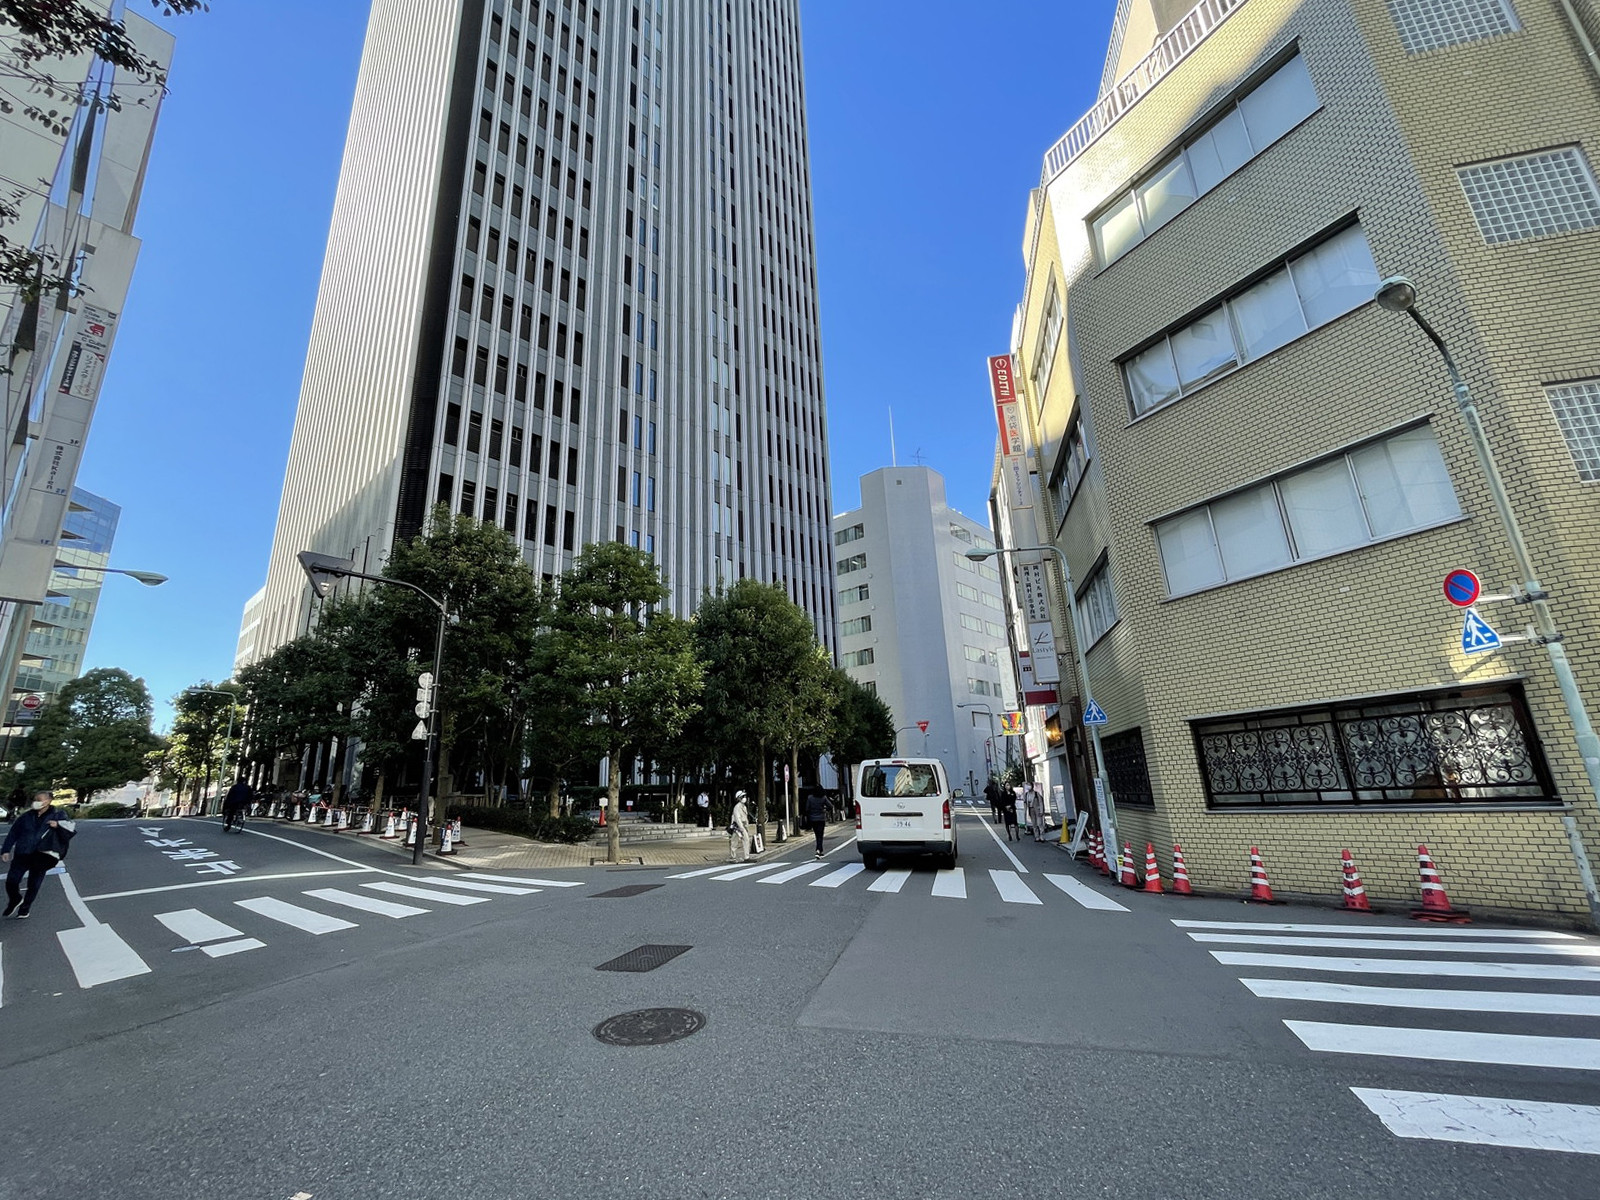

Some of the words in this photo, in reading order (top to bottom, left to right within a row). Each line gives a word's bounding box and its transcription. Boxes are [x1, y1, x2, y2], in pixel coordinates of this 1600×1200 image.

[997, 369, 1010, 396] EDITH
[1007, 415, 1021, 453] 池袋医学館
